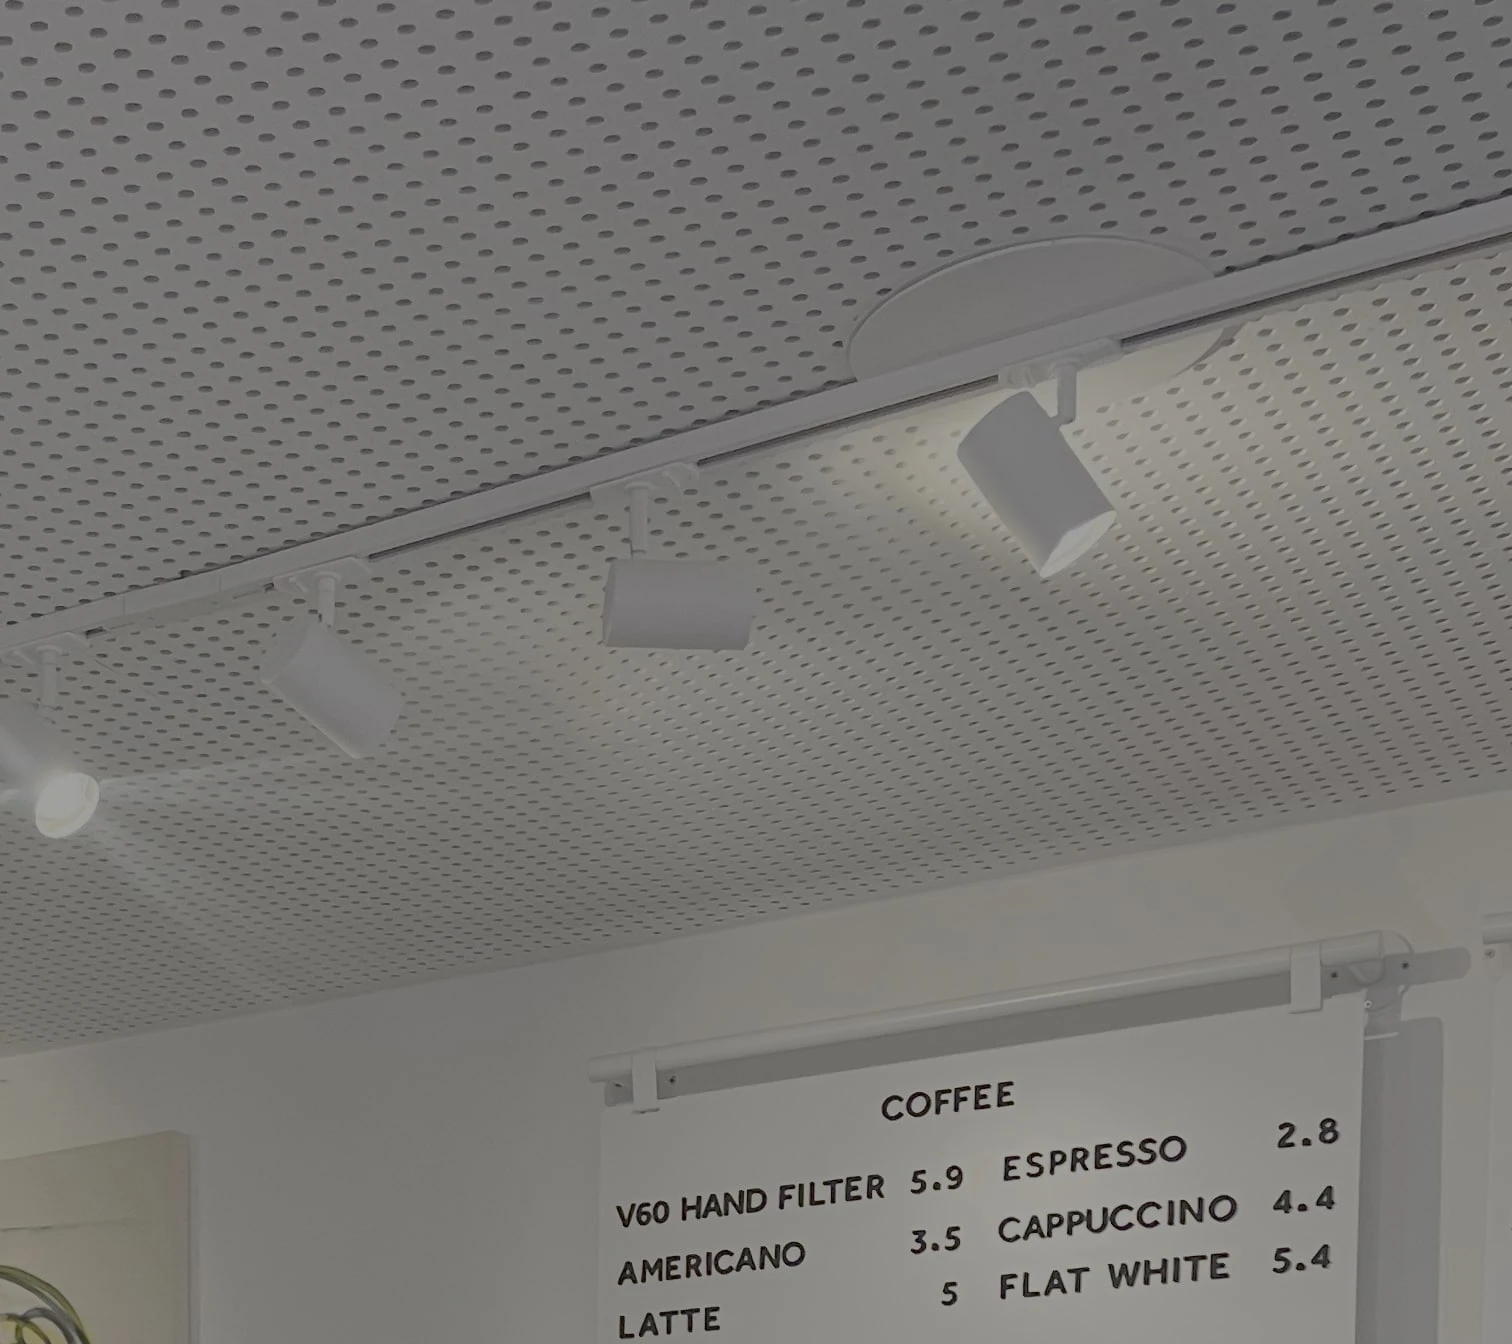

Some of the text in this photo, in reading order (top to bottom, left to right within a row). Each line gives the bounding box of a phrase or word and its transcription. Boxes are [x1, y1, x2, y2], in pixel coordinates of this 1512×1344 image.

[881, 1080, 1015, 1122] COFFEE
[1003, 1117, 1339, 1182] ESPRESSO 2.8
[615, 1165, 963, 1229] V60 HAND FILTER 5.9
[998, 1185, 1336, 1243] CAPPUCCINO 4.4
[617, 1225, 961, 1286] AMERICANO 3.5
[999, 1243, 1331, 1300] FLAT WHITE 5.4
[618, 1281, 958, 1340] LATTE 5
